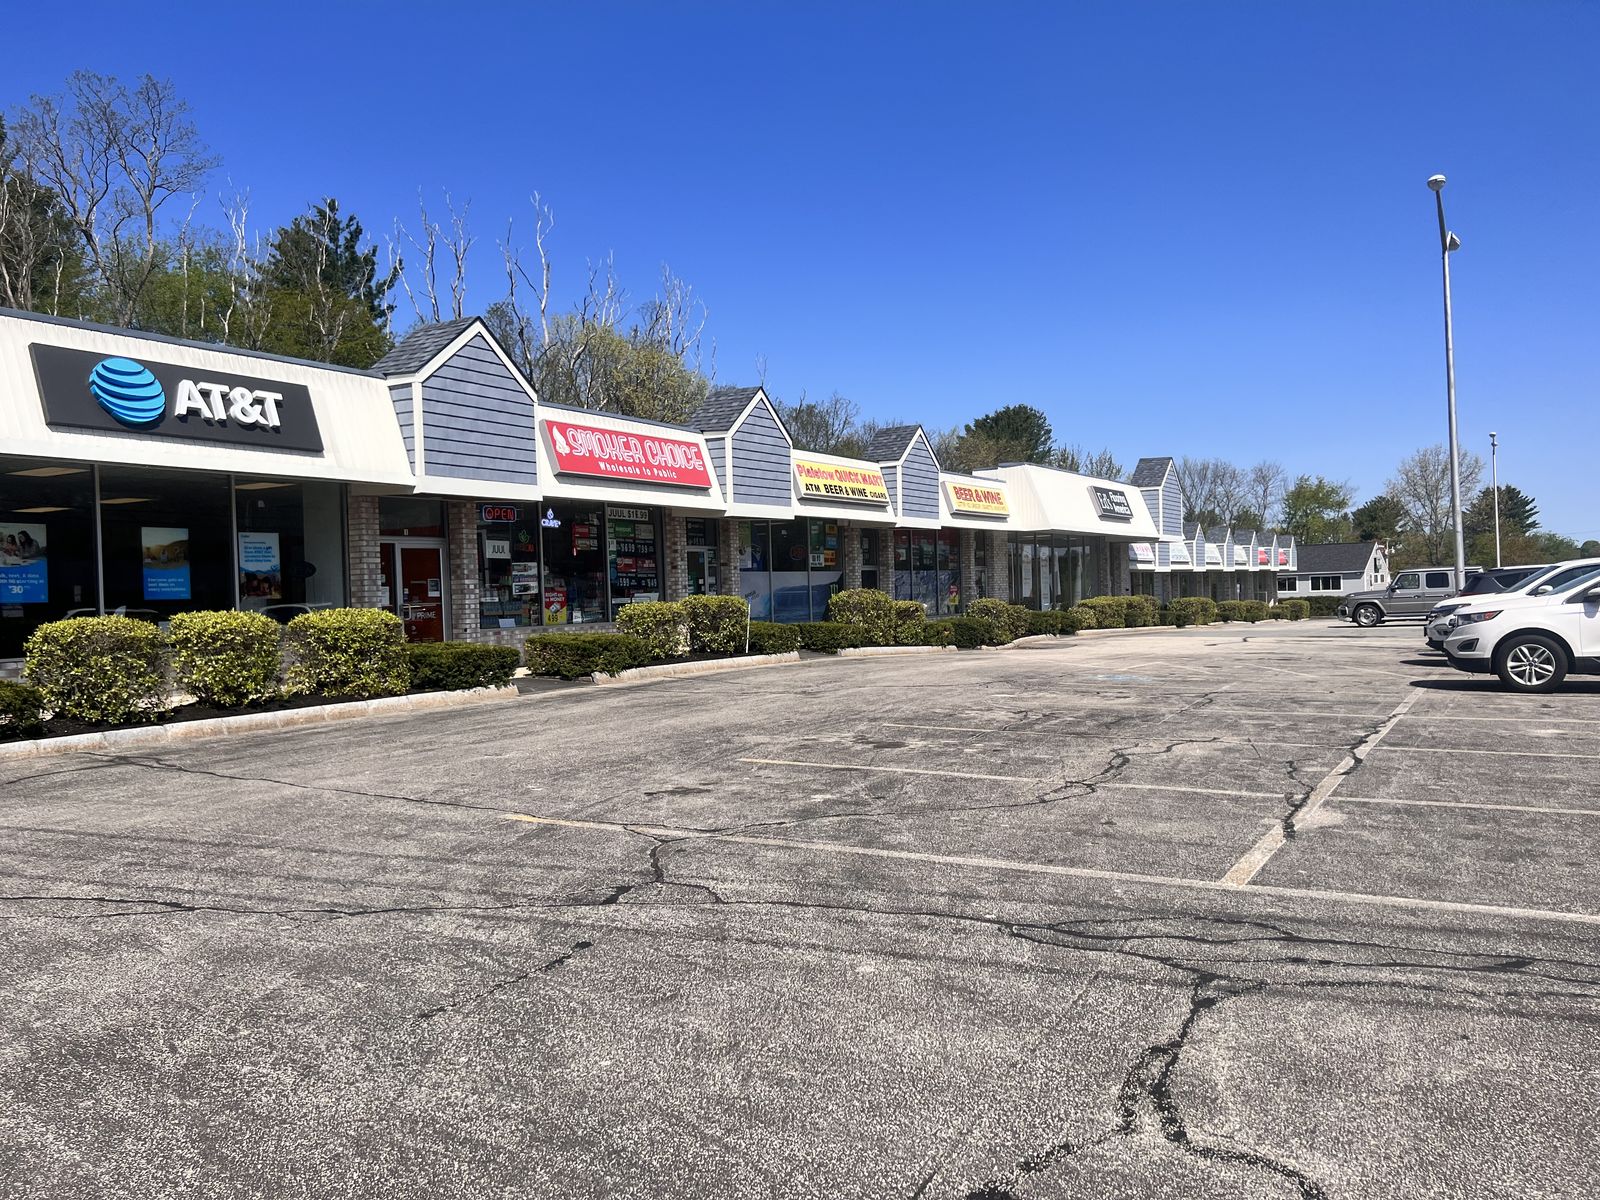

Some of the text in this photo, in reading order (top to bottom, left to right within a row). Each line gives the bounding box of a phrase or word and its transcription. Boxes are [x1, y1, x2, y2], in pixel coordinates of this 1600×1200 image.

[174, 379, 283, 429] AT&T
[566, 428, 704, 471] SMOKER CHOICE
[598, 461, 677, 479] Wholesale to Public
[834, 469, 862, 484] QUICK
[860, 473, 885, 487] MART
[805, 483, 887, 500] ATM BEER & WINE CIGARS
[953, 485, 1004, 505] BEER & WINE
[485, 507, 514, 521] OPEN
[609, 508, 626, 518] JUUL
[492, 544, 506, 554] JUUL
